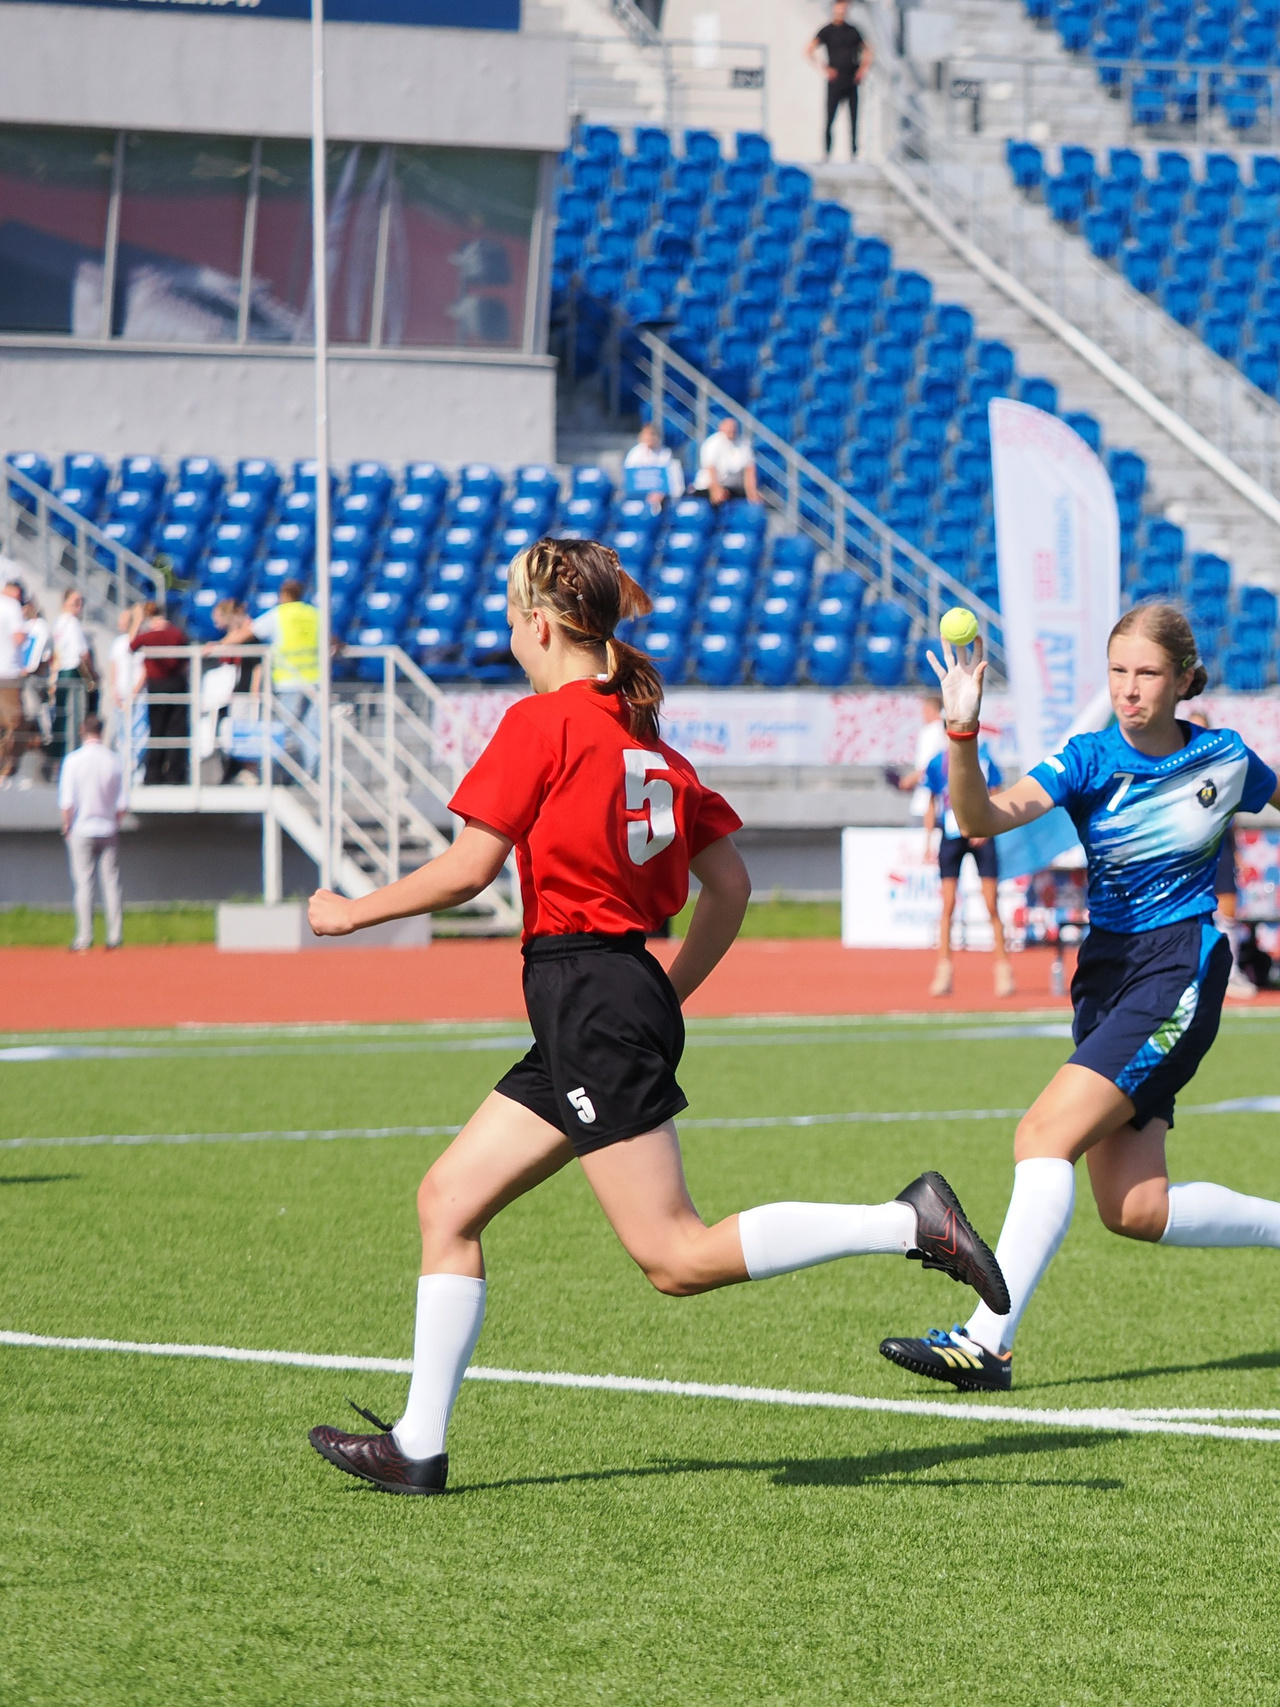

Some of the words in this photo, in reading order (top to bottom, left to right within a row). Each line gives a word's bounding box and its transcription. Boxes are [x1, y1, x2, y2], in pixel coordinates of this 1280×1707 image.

[622, 748, 676, 866] 5
[1106, 772, 1135, 812] 7
[566, 1086, 597, 1124] 5
